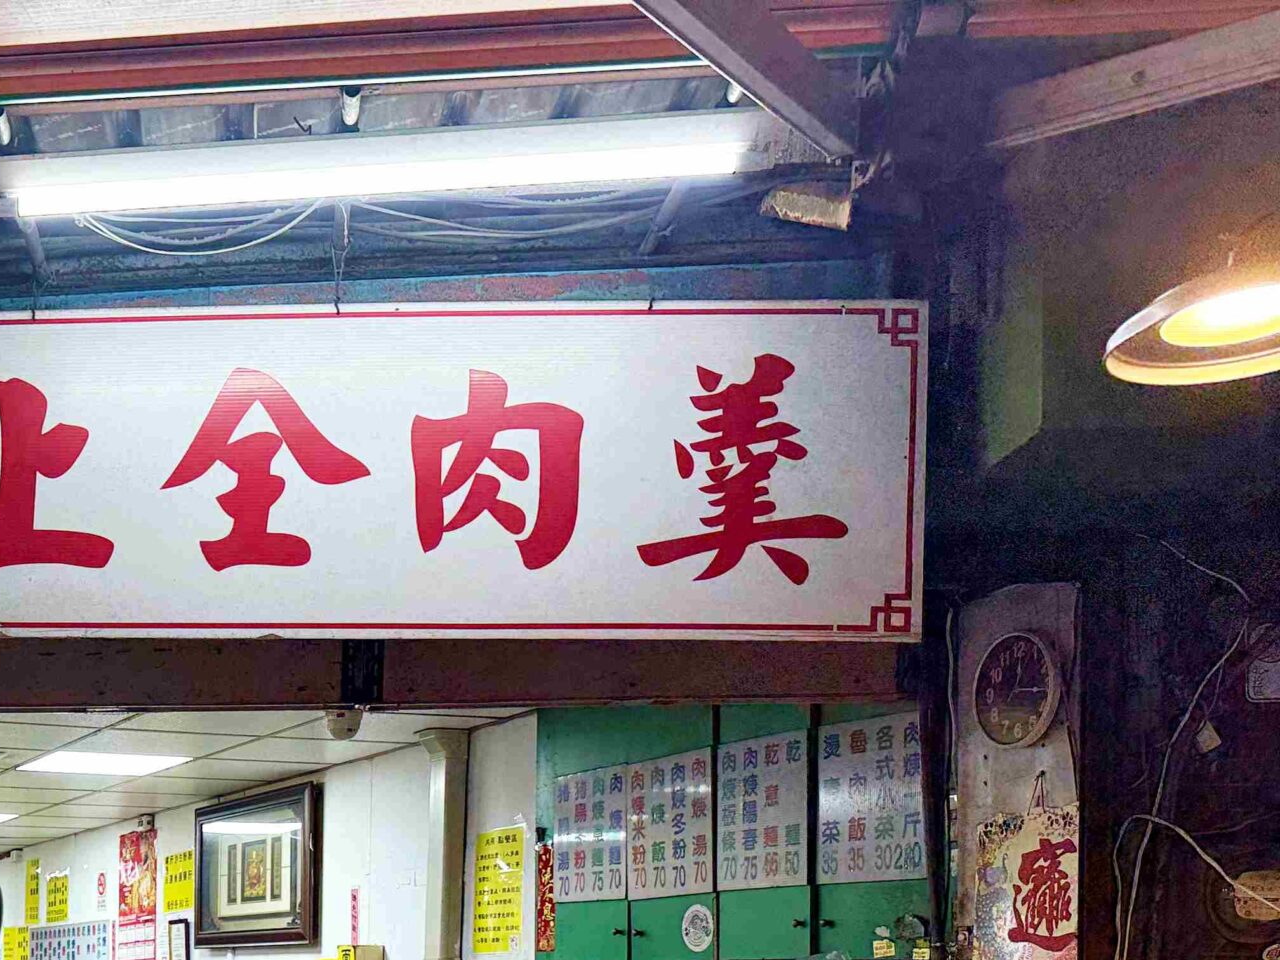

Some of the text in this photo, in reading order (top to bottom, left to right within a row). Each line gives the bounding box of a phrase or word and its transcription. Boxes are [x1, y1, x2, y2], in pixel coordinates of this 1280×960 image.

[990, 667, 1003, 684] 10
[986, 688, 995, 703] 9
[990, 707, 999, 723] 8
[1001, 719, 1010, 735] 7
[1013, 722, 1022, 739] 6
[743, 855, 758, 881] 75
[821, 850, 840, 876] 35
[847, 847, 866, 874] 35
[874, 844, 893, 871] 30
[608, 868, 622, 890] 70
[633, 867, 647, 889] 70
[652, 866, 667, 889] 70
[671, 864, 687, 889] 70
[692, 860, 708, 885] 70
[722, 857, 738, 881] 70
[558, 875, 570, 898] 70
[574, 872, 585, 894] 70
[591, 870, 604, 892] 75
